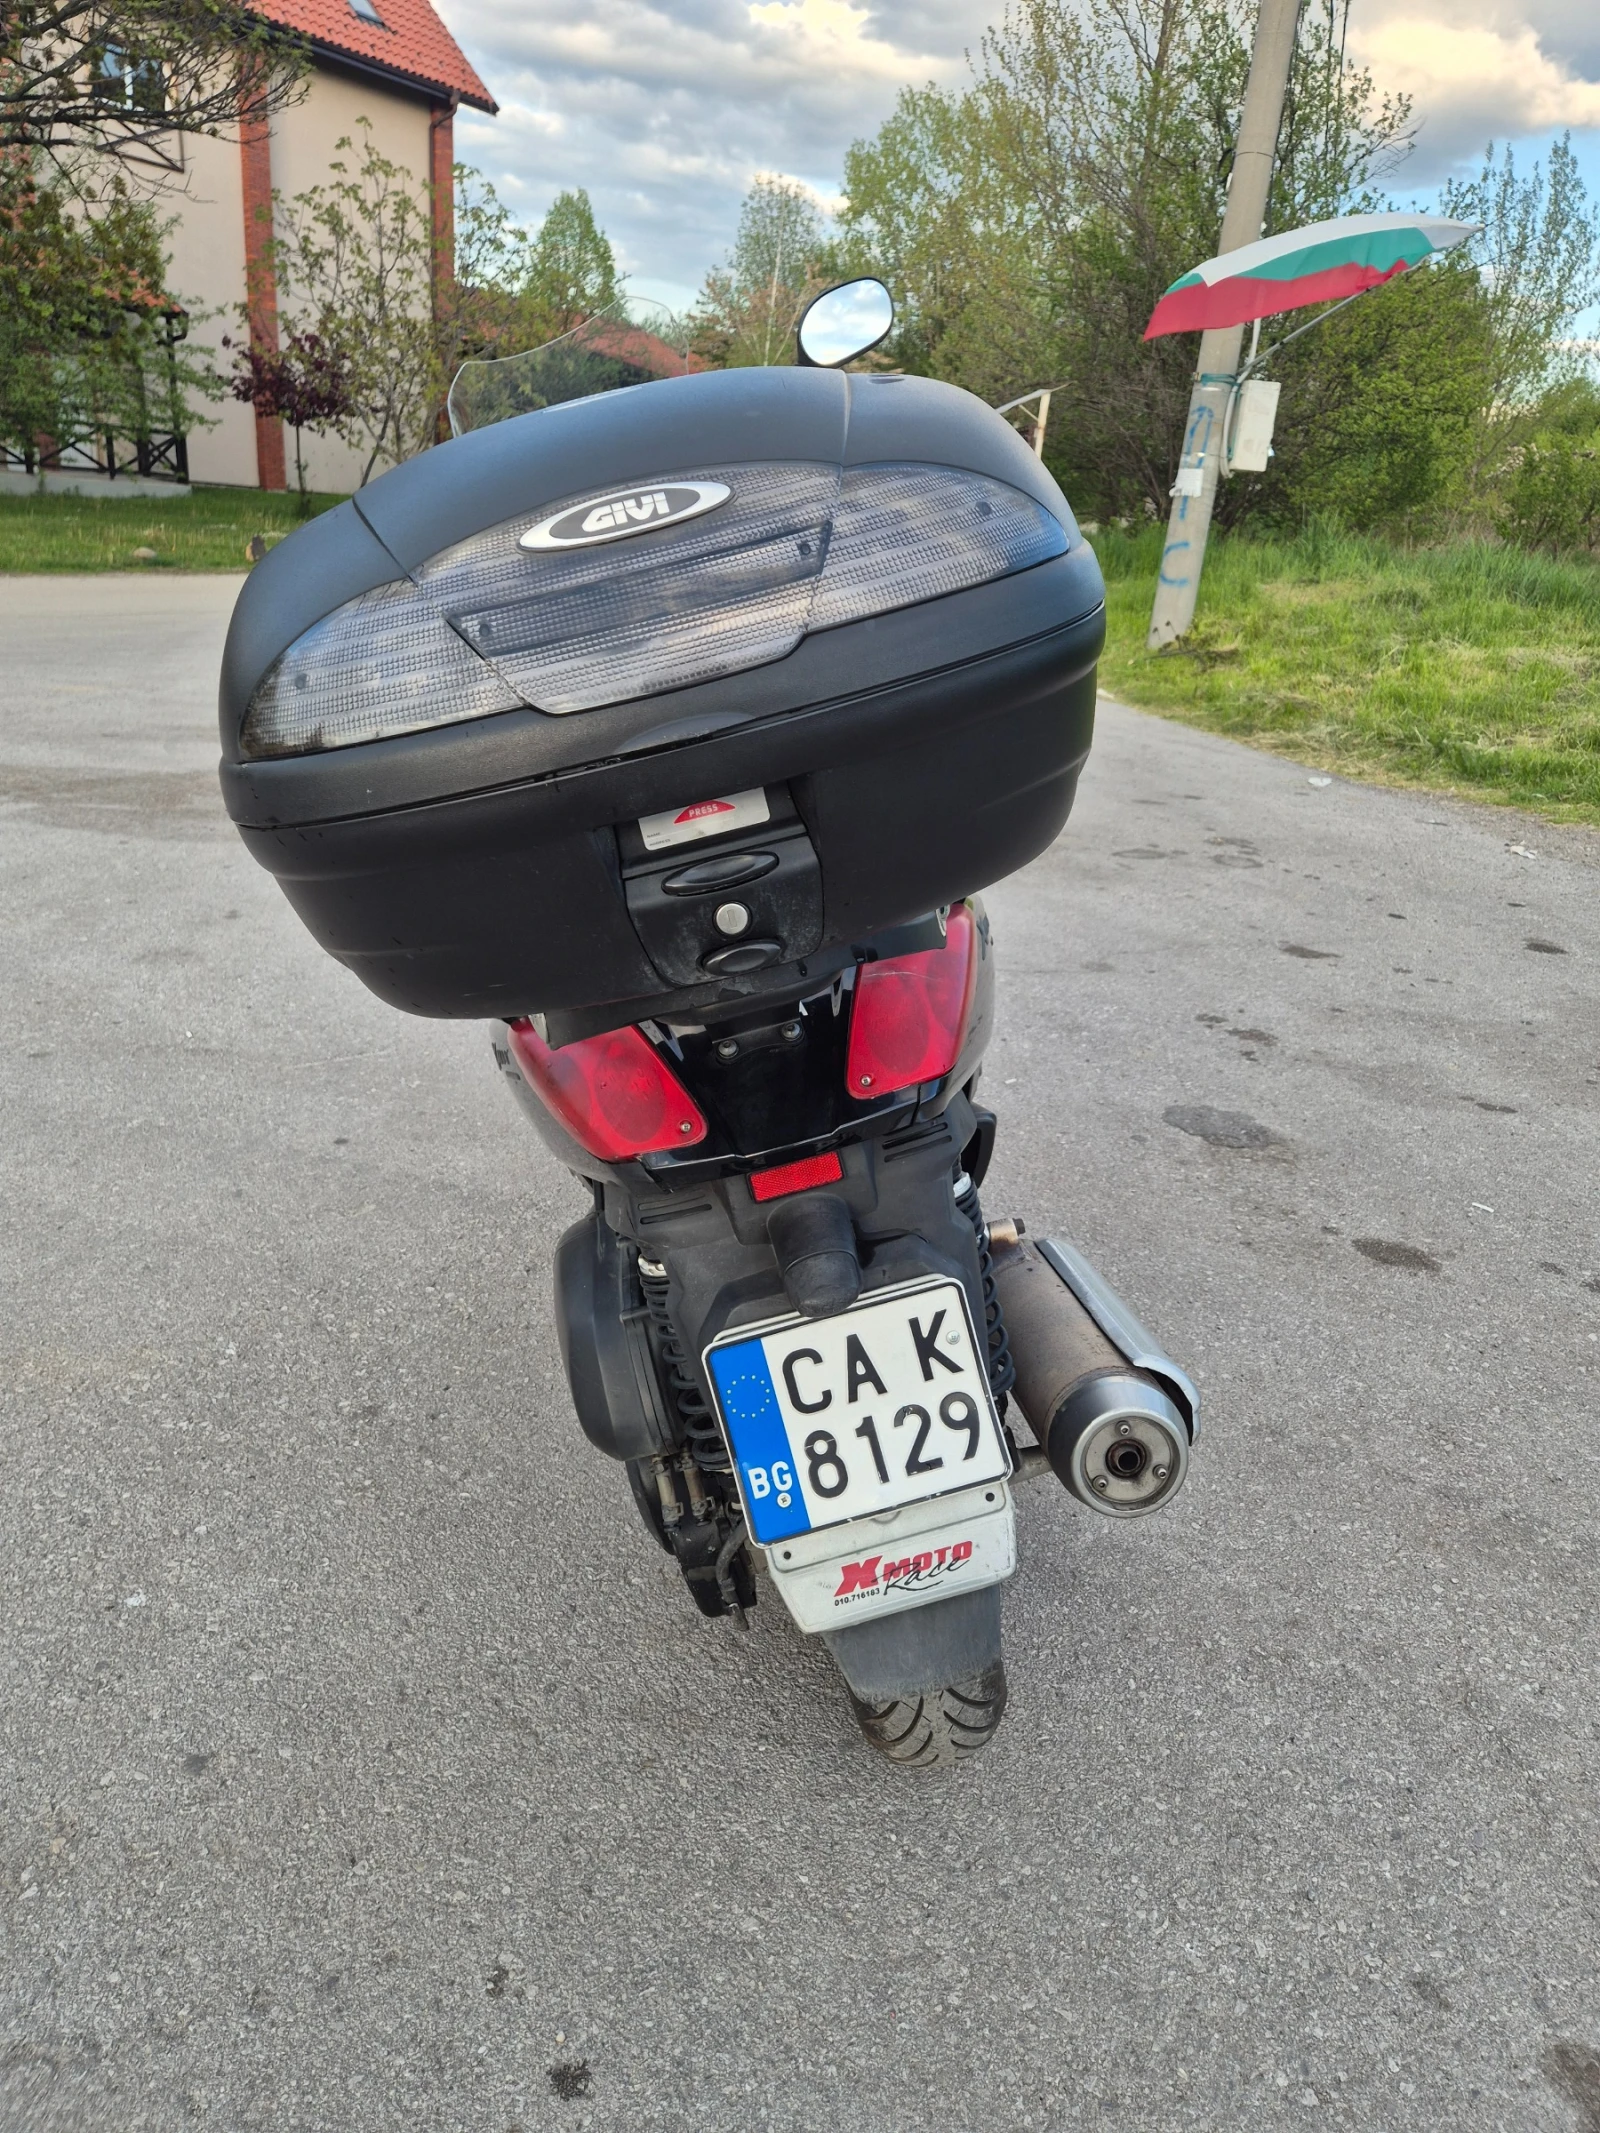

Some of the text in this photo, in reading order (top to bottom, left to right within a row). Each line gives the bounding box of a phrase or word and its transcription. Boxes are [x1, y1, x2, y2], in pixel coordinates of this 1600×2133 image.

[581, 492, 670, 532] GIVI
[688, 803, 719, 818] PRESS
[781, 1308, 965, 1414] CA K
[803, 1391, 981, 1500] 8129
[747, 1461, 793, 1500] BG
[870, 1556, 970, 1596] Race
[834, 1588, 881, 1607] 010.716183
